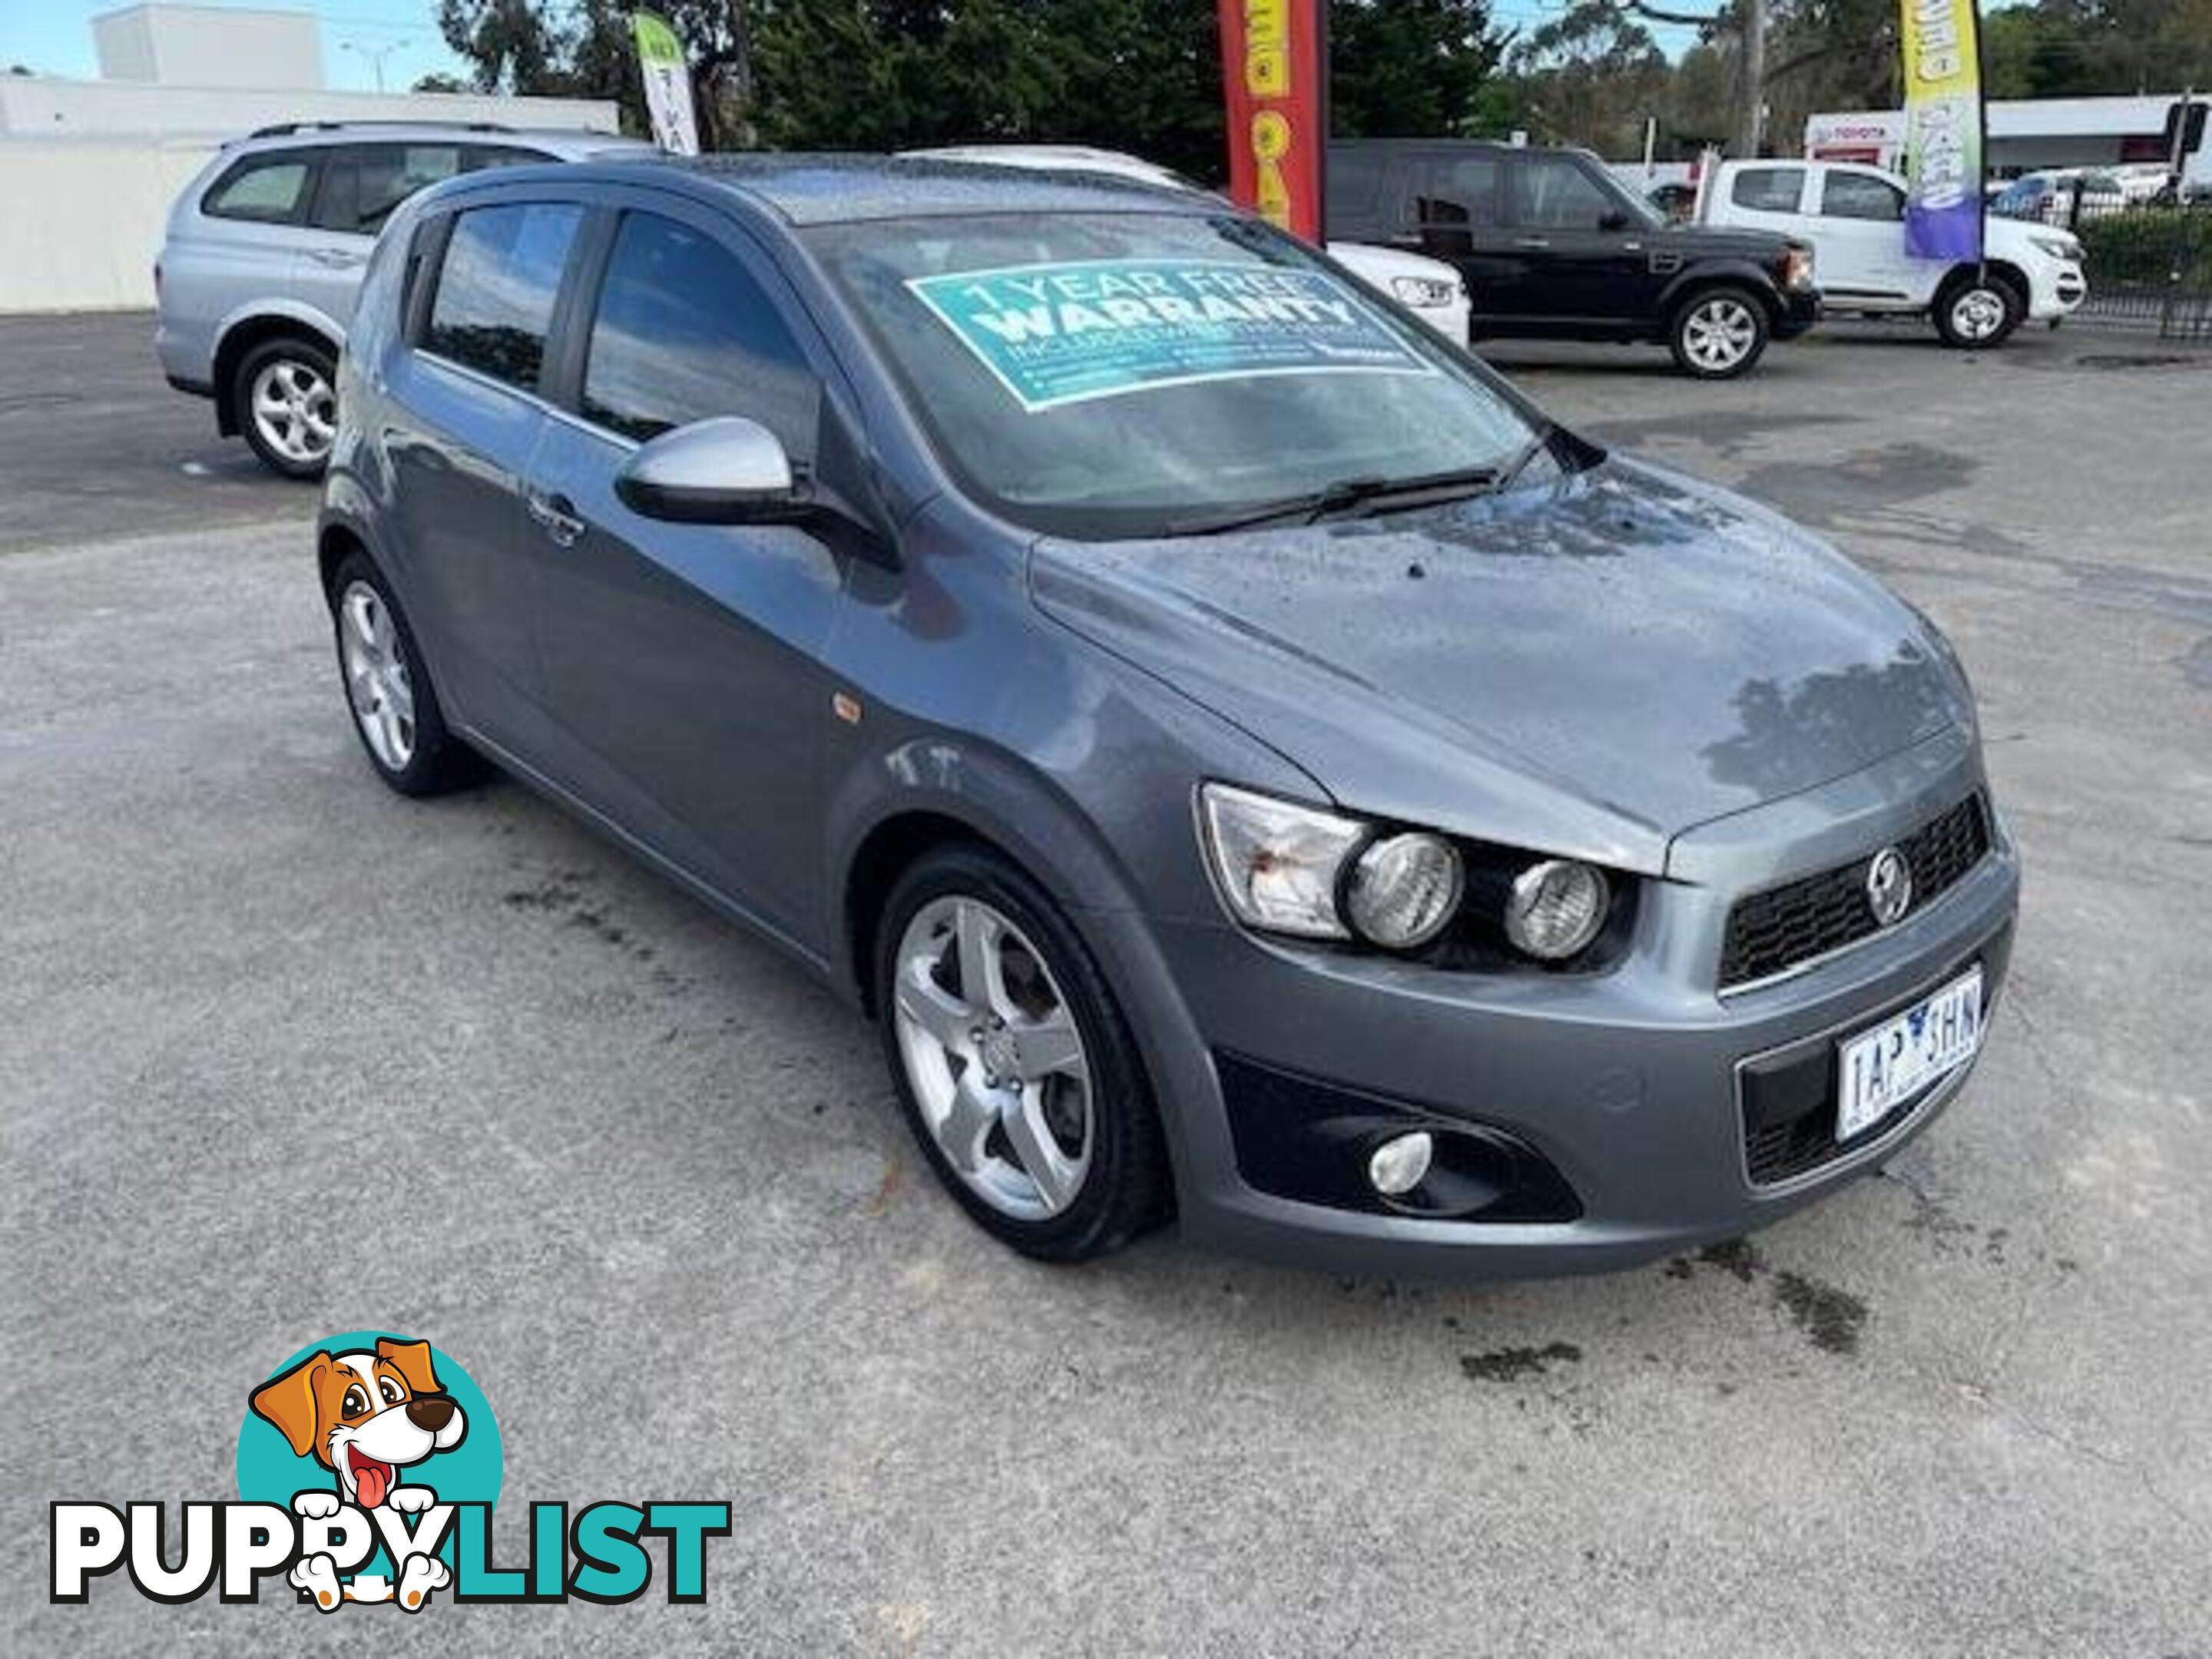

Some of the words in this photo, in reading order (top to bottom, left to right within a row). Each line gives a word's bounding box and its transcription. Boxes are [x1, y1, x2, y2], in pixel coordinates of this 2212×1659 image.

[1835, 127, 1885, 139] TOYOTA
[1002, 273, 1178, 303] YEAR
[1178, 272, 1310, 296] FREE
[969, 295, 1356, 343] WARRANTY
